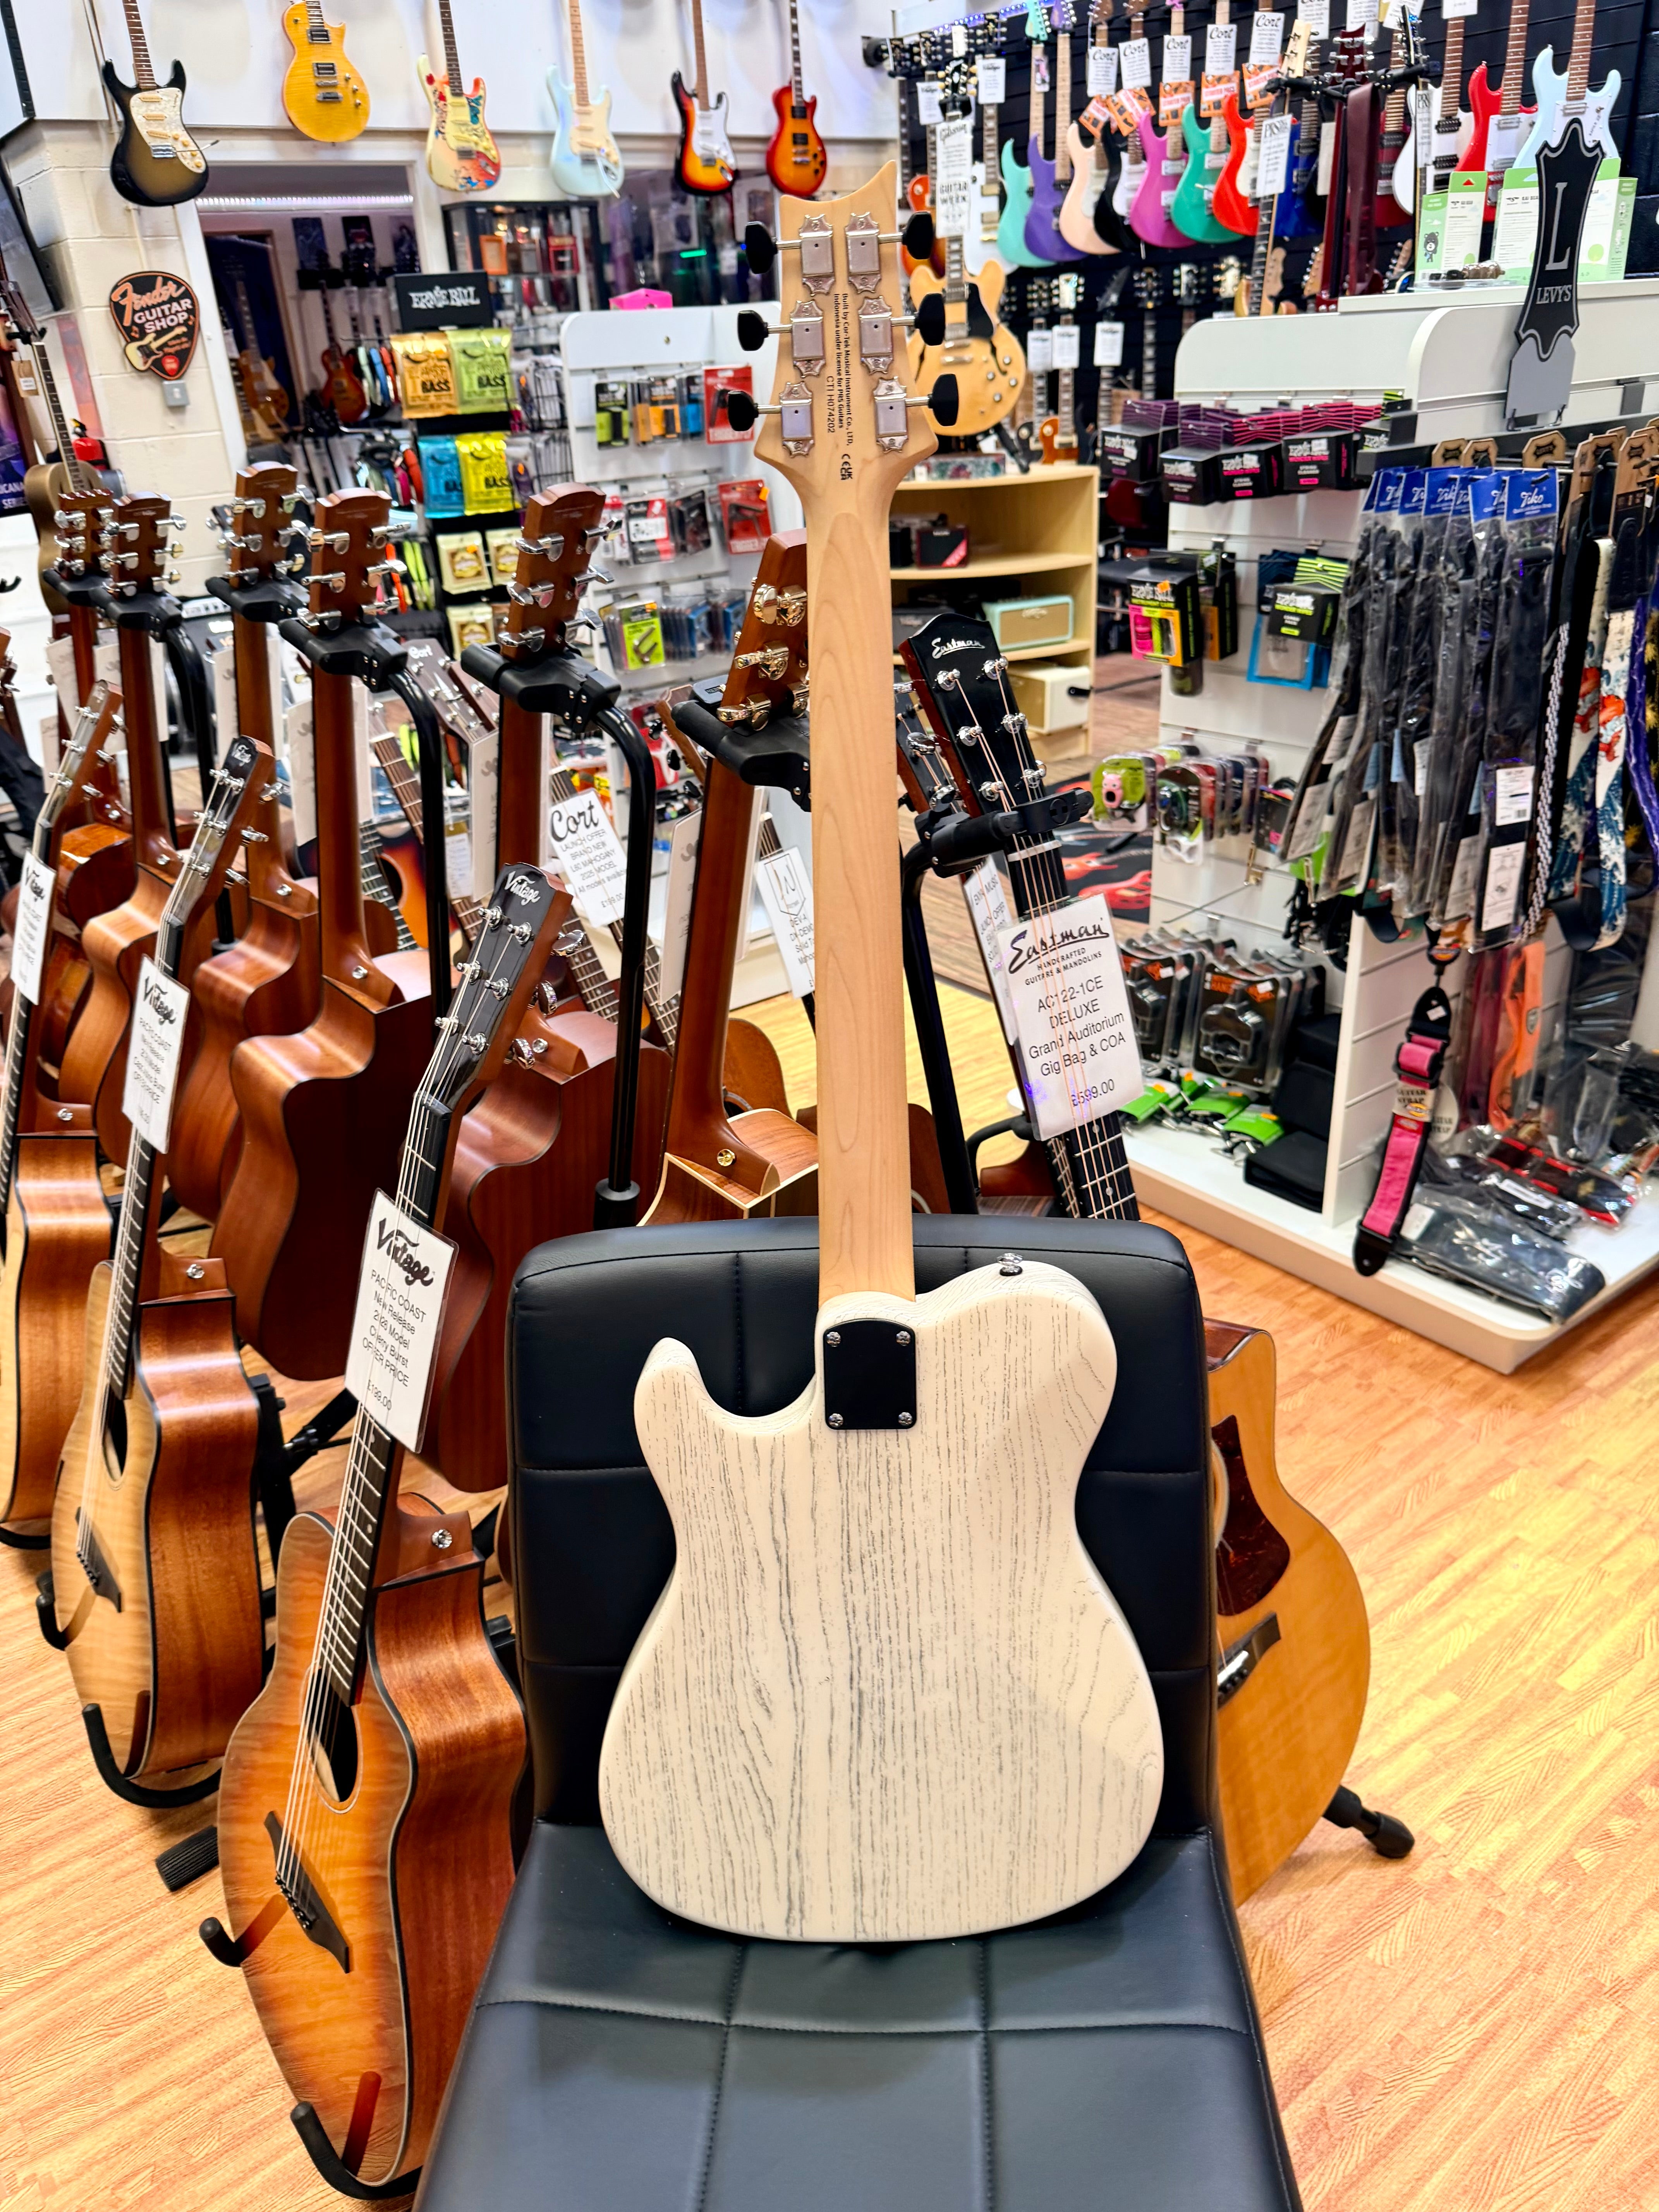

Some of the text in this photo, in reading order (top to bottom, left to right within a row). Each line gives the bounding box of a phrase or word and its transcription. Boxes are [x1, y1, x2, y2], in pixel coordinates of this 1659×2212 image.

[111, 276, 186, 326] Fender
[1536, 285, 1572, 304] LEVY'S
[133, 299, 193, 324] GUITAR
[144, 311, 188, 333] SHOP
[842, 311, 849, 320] by
[931, 637, 986, 659] Eastman
[551, 800, 599, 842] Cort
[561, 829, 607, 852] LAUNCH OFFER
[570, 841, 607, 860] BRAND NEW
[596, 860, 617, 873] MODEL
[504, 871, 541, 905] Vintage
[1009, 924, 1110, 974] Eastman
[1062, 951, 1102, 973] MANDOLINS
[1049, 999, 1101, 1030] DELUXE
[1029, 1011, 1125, 1060] Grand Auditorium
[1041, 1031, 1127, 1077] Gig Bag & COA
[376, 1217, 434, 1287] Vintage
[371, 1269, 426, 1323] PACIFIC COAST
[373, 1290, 416, 1335] New Release
[369, 1325, 408, 1369] Cerry Burst
[388, 1324, 410, 1350] Model
[362, 1337, 409, 1388] OFFER PRICE
